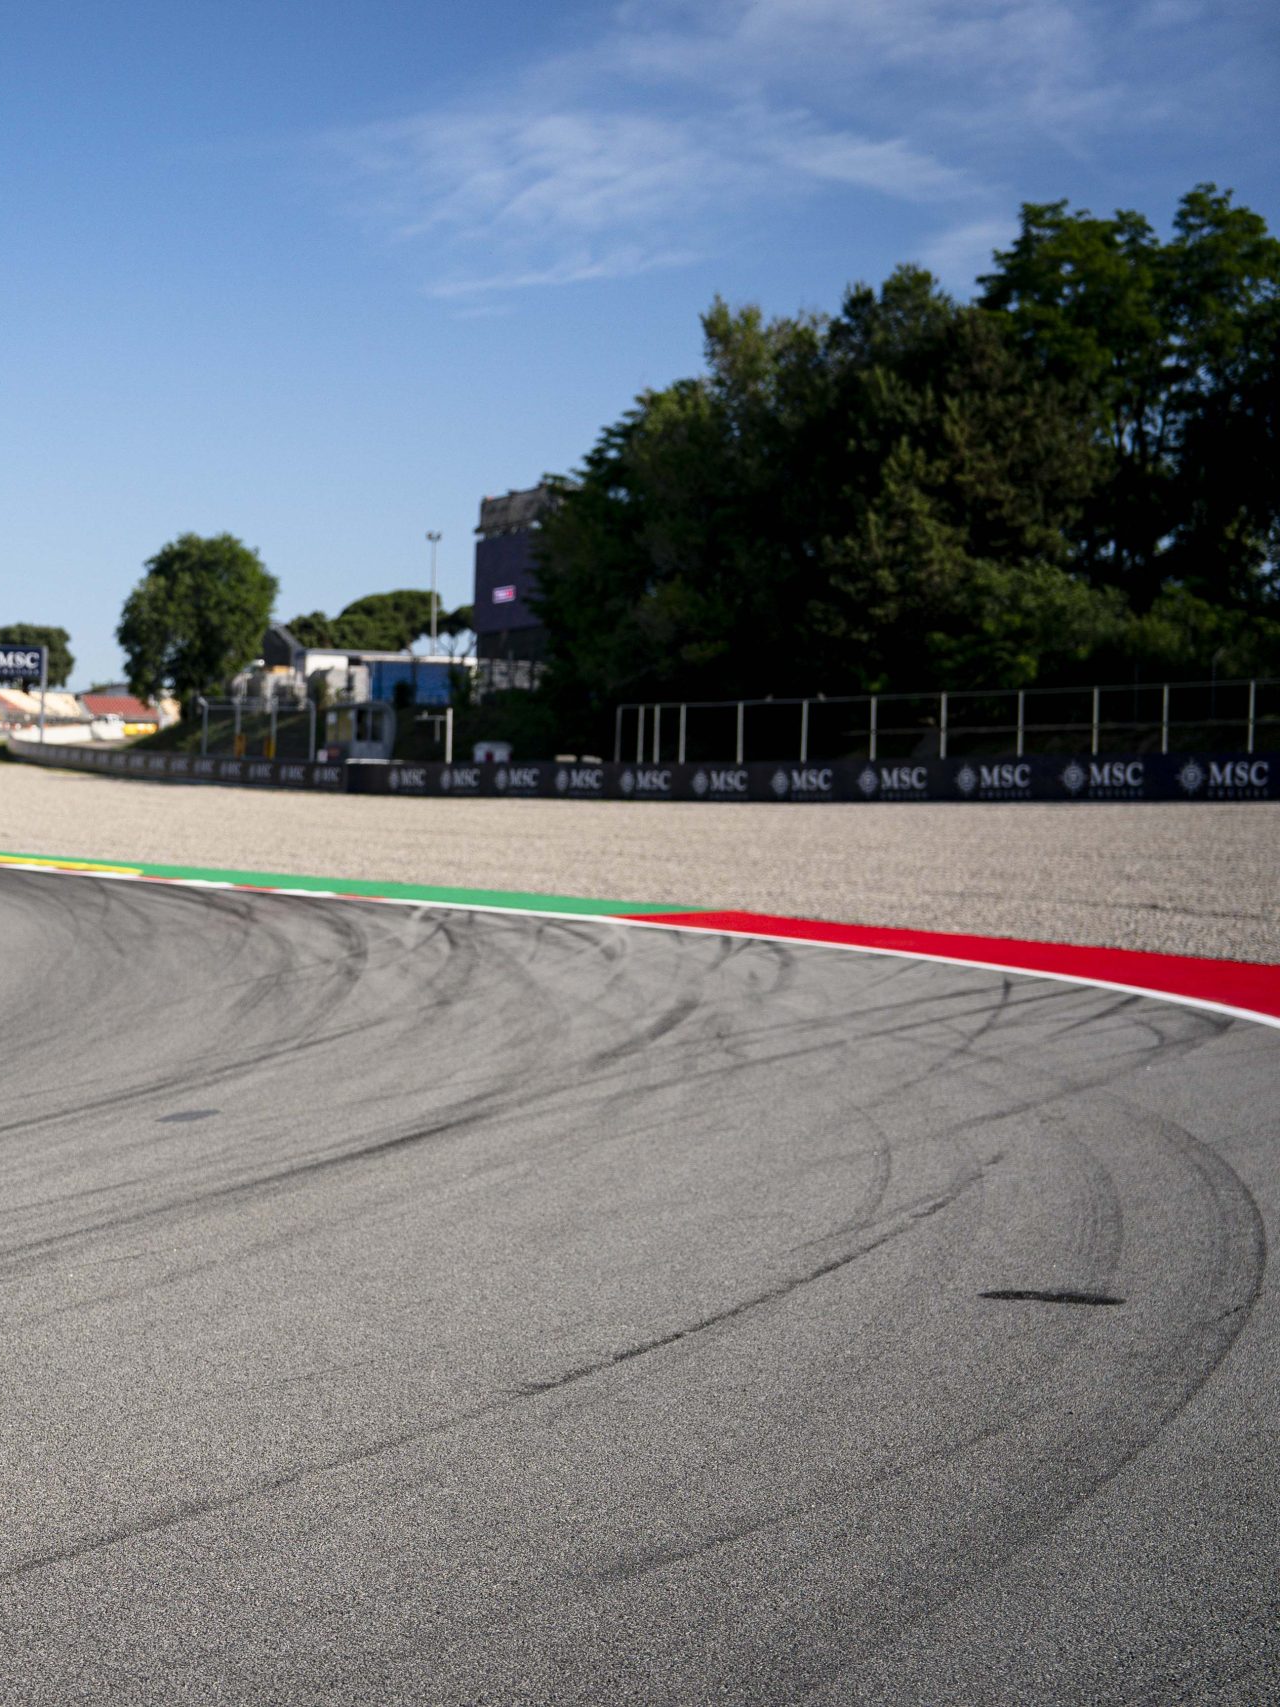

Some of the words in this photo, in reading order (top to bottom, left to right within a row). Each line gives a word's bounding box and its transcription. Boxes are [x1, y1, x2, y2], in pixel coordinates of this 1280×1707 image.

[636, 769, 672, 791] MSC
[710, 770, 748, 791] MSC
[791, 768, 833, 791] MSC
[881, 766, 928, 790] MSC
[980, 763, 1031, 789] MSC
[1089, 761, 1144, 787] MSC
[1207, 760, 1270, 788] MSC
